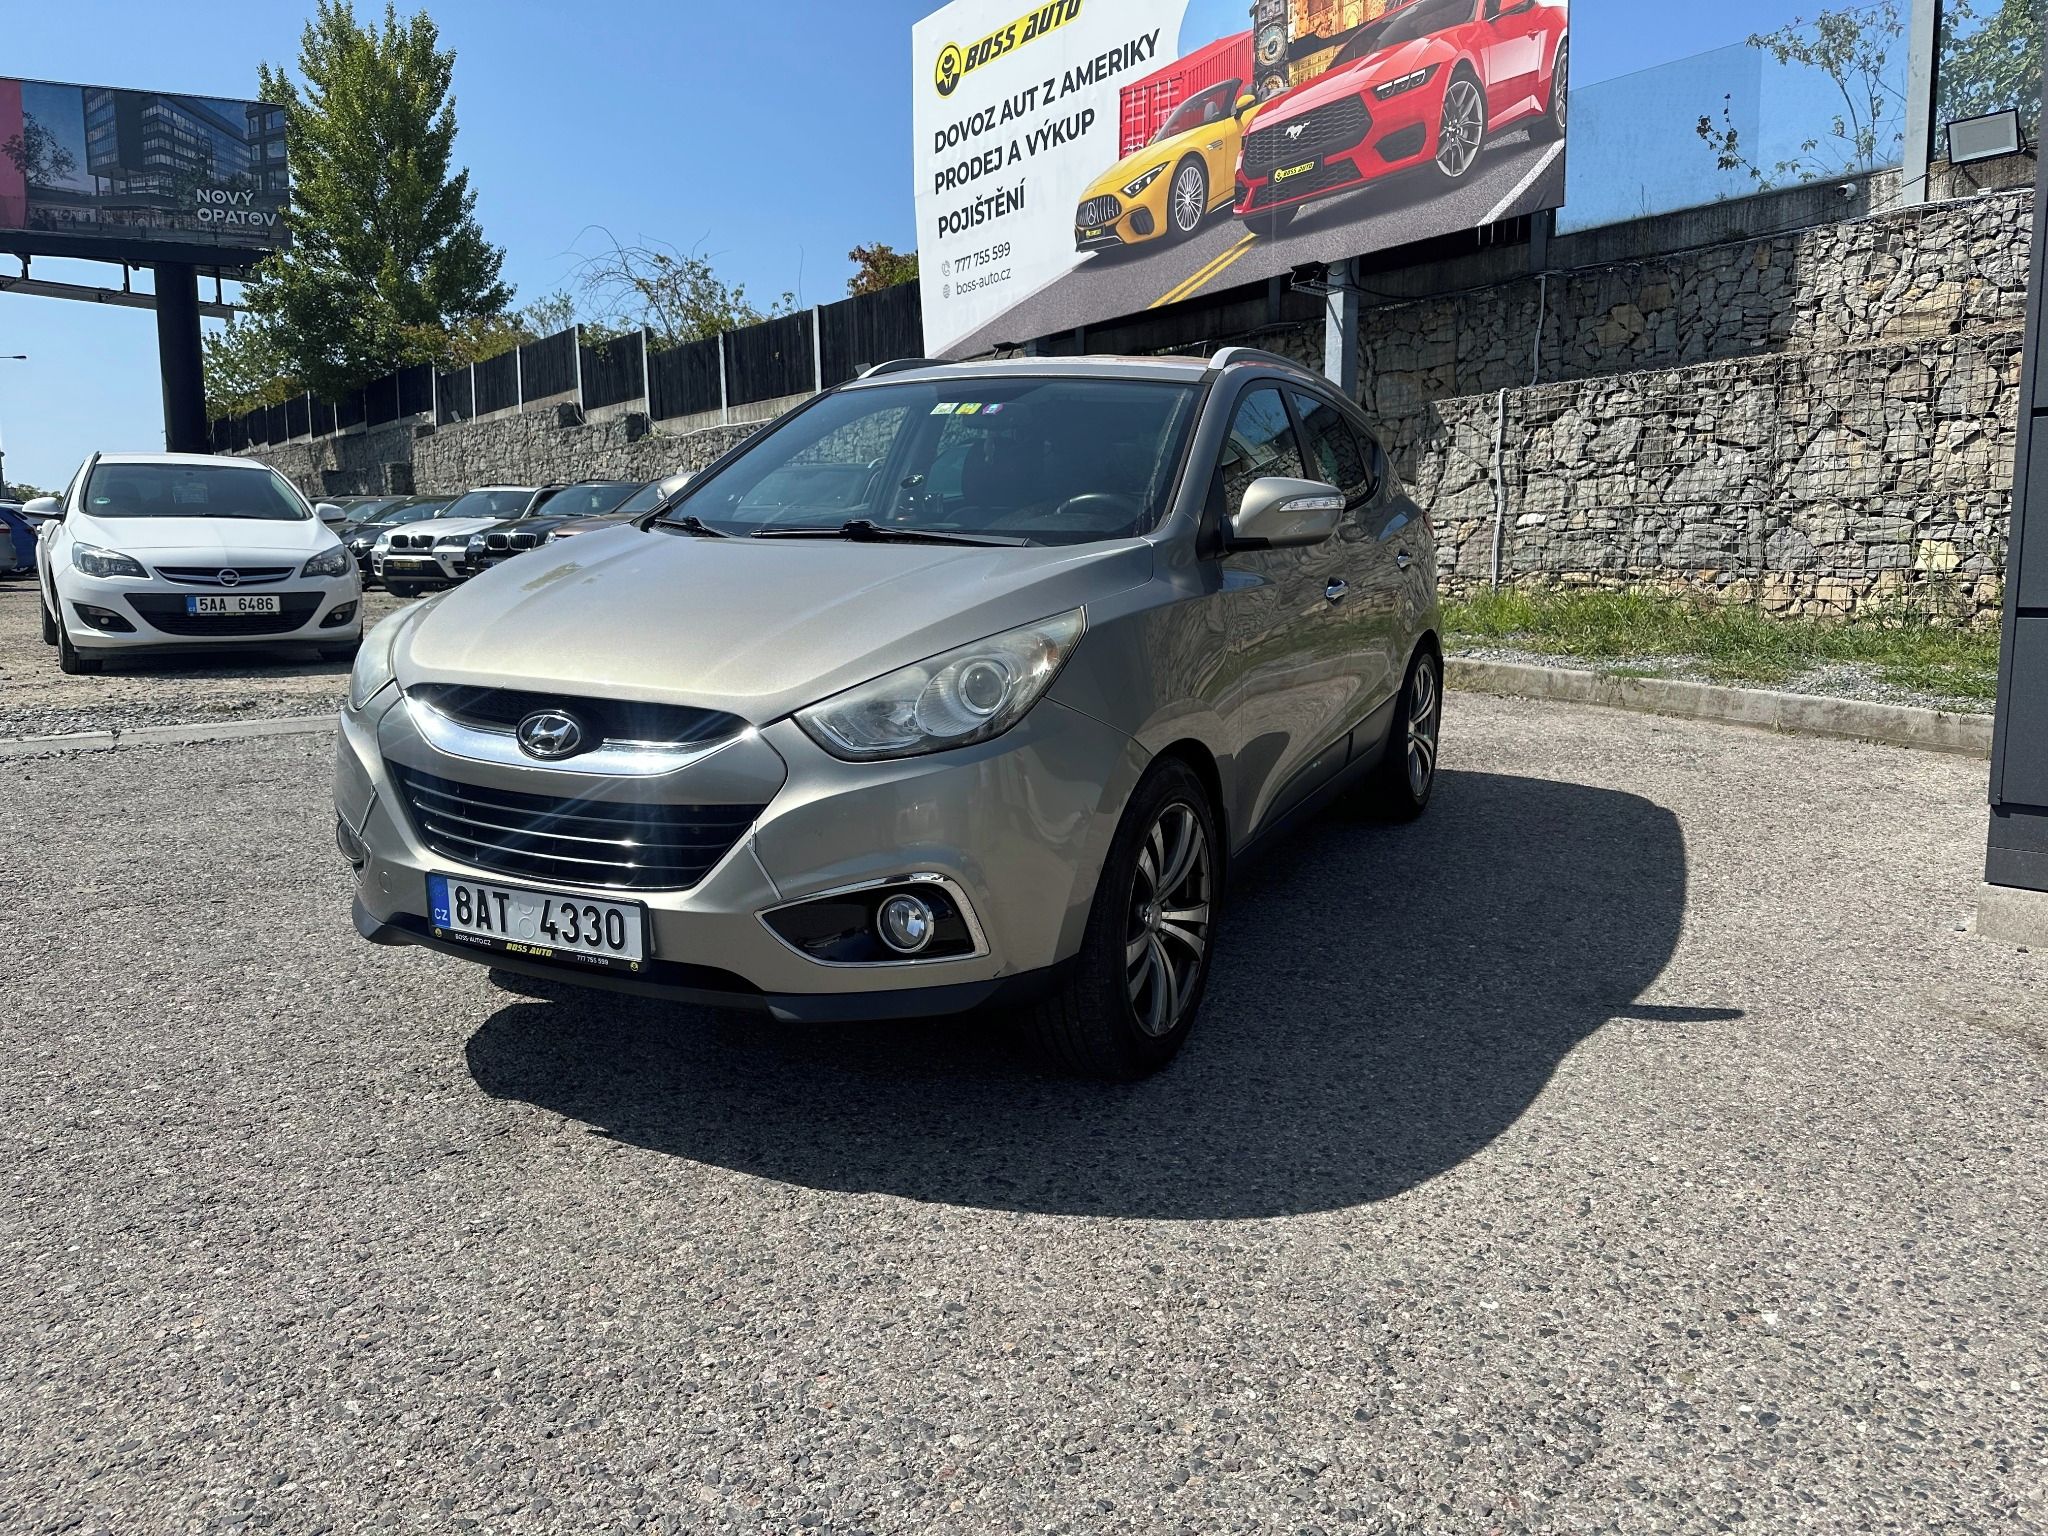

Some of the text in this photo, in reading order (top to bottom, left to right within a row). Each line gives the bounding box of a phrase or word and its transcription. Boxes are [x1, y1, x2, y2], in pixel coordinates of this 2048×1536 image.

[964, 0, 1081, 73] BOSS AUTO
[934, 28, 1160, 154] DOVOZ AUT Z AMERIKY
[935, 108, 1095, 195] PRODEJ A VÝKUP
[196, 189, 254, 206] NOVÝ
[938, 177, 1026, 238] POJIŠTĚNÍ
[197, 208, 277, 227] OPATOV
[954, 241, 1011, 273] 777 755 599
[956, 268, 1011, 295] boss-auto.cz
[200, 598, 274, 611] 5AA 6486
[434, 907, 448, 921] CZ
[454, 886, 625, 950] 8AT 4330
[506, 942, 553, 957] BOSS AUTO
